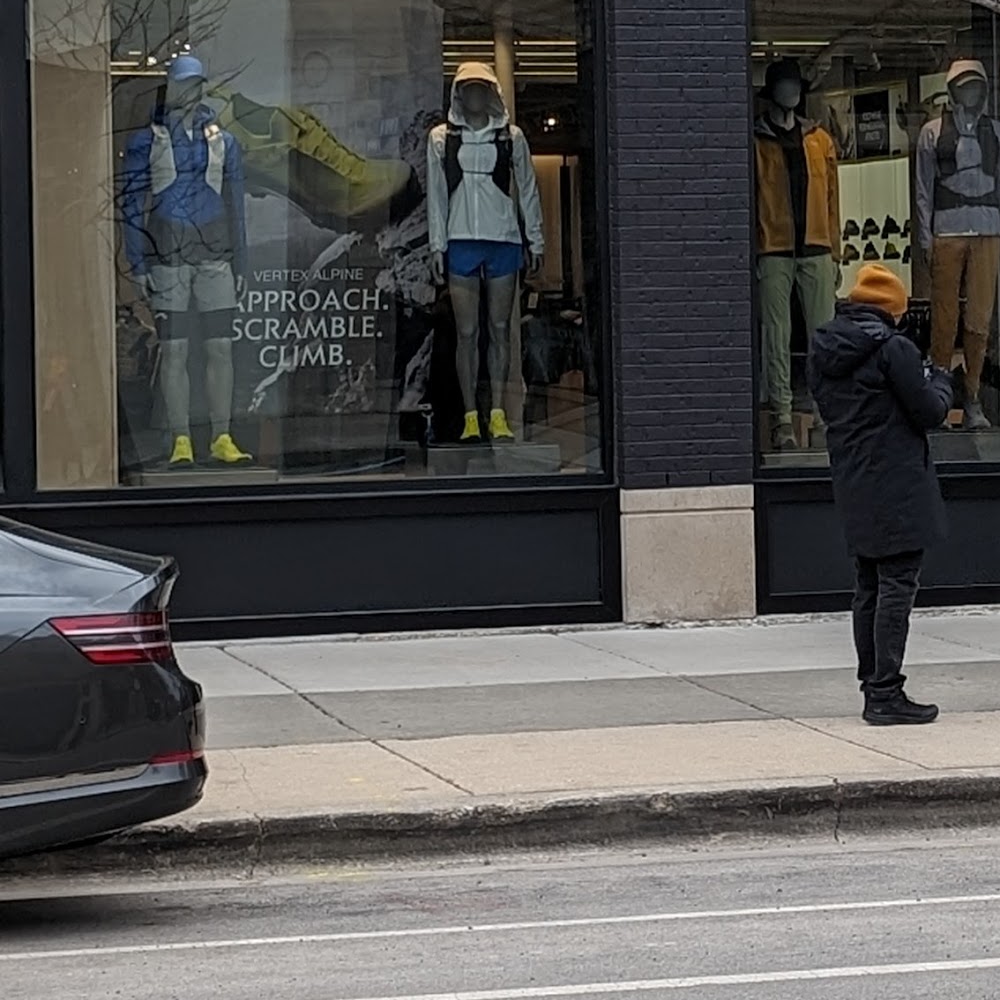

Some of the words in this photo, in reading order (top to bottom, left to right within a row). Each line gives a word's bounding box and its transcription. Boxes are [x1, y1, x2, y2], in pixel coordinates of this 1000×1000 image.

[253, 269, 309, 282] VERTEX
[312, 268, 364, 281] ALPINE
[231, 315, 383, 341] SCRAMBLE.
[259, 344, 352, 368] CLIMB.
